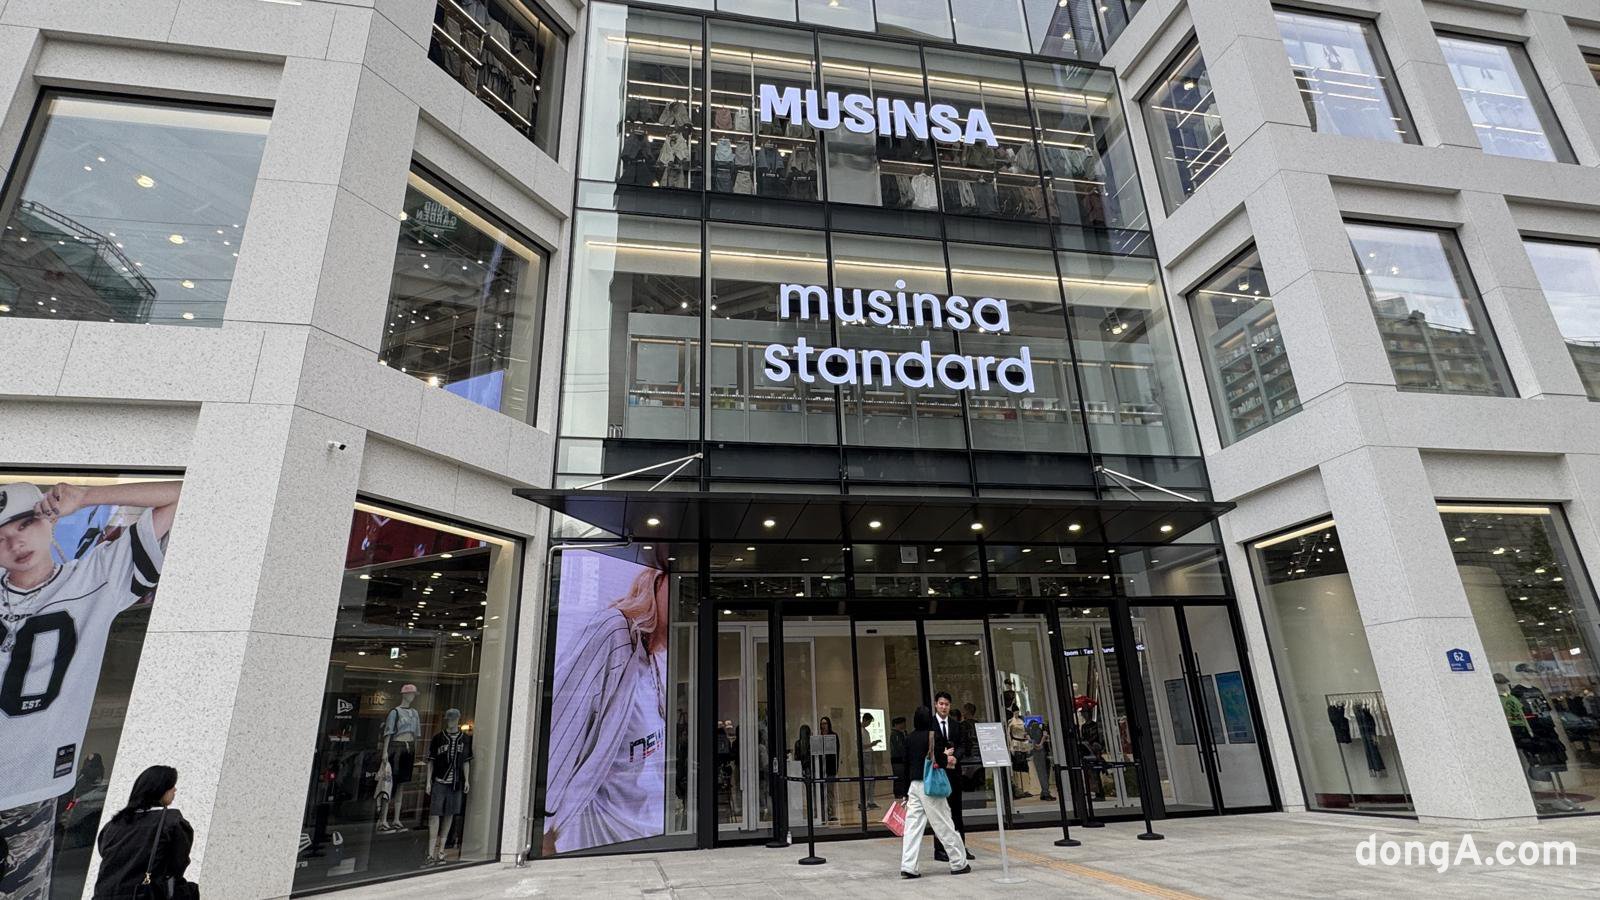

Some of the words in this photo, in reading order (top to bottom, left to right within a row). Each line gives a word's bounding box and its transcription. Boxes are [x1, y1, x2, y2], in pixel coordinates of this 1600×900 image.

[759, 84, 998, 148] MUSINSA
[780, 279, 1010, 332] musinsa
[764, 337, 1035, 393] standard
[0, 610, 78, 716] 0
[1453, 651, 1465, 661] 62
[21, 699, 42, 710] EST.
